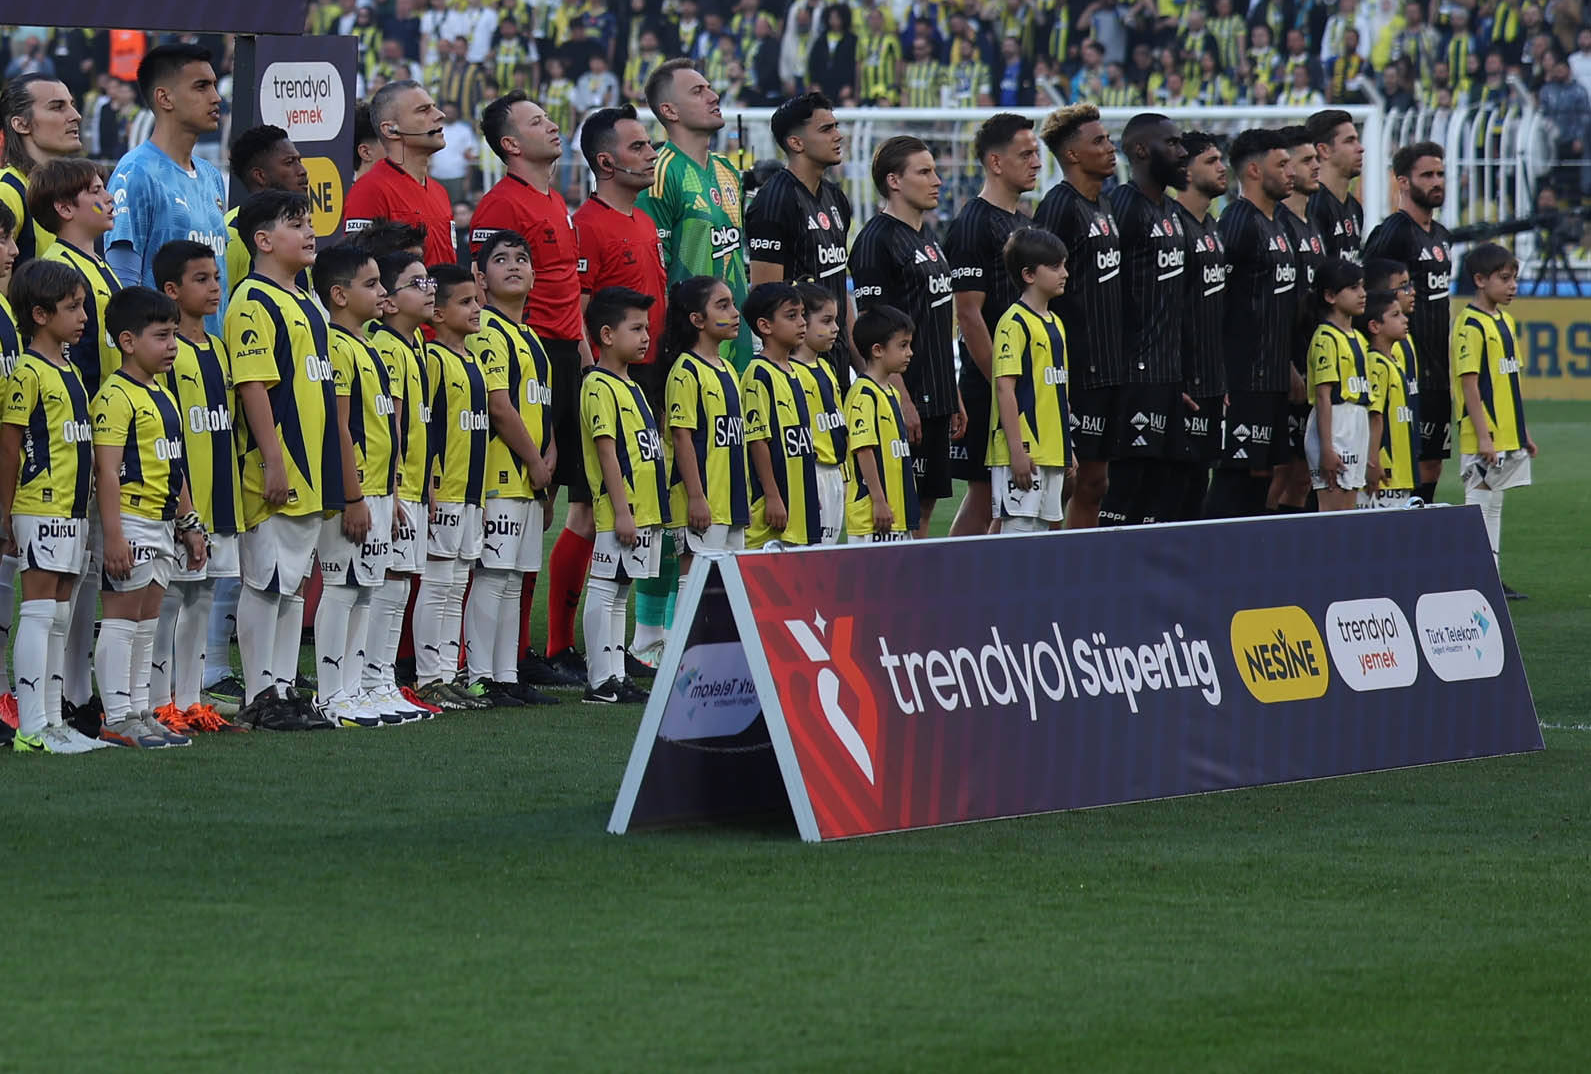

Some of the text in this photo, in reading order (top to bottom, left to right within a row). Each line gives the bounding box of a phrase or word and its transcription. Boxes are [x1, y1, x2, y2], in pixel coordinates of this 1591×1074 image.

[273, 75, 331, 103] trendyol
[286, 105, 323, 127] yemek
[750, 238, 781, 251] apara
[818, 243, 847, 264] beko
[951, 265, 983, 278] apara
[236, 347, 268, 359] ALPET
[1082, 415, 1106, 433] BAU
[1251, 425, 1272, 441] BAU
[38, 520, 76, 541] pürsu
[1337, 612, 1399, 645] trendyol
[1425, 625, 1480, 645] Türk Telekom
[879, 621, 1222, 721] trendyol süperLig
[1358, 650, 1398, 676] yemek
